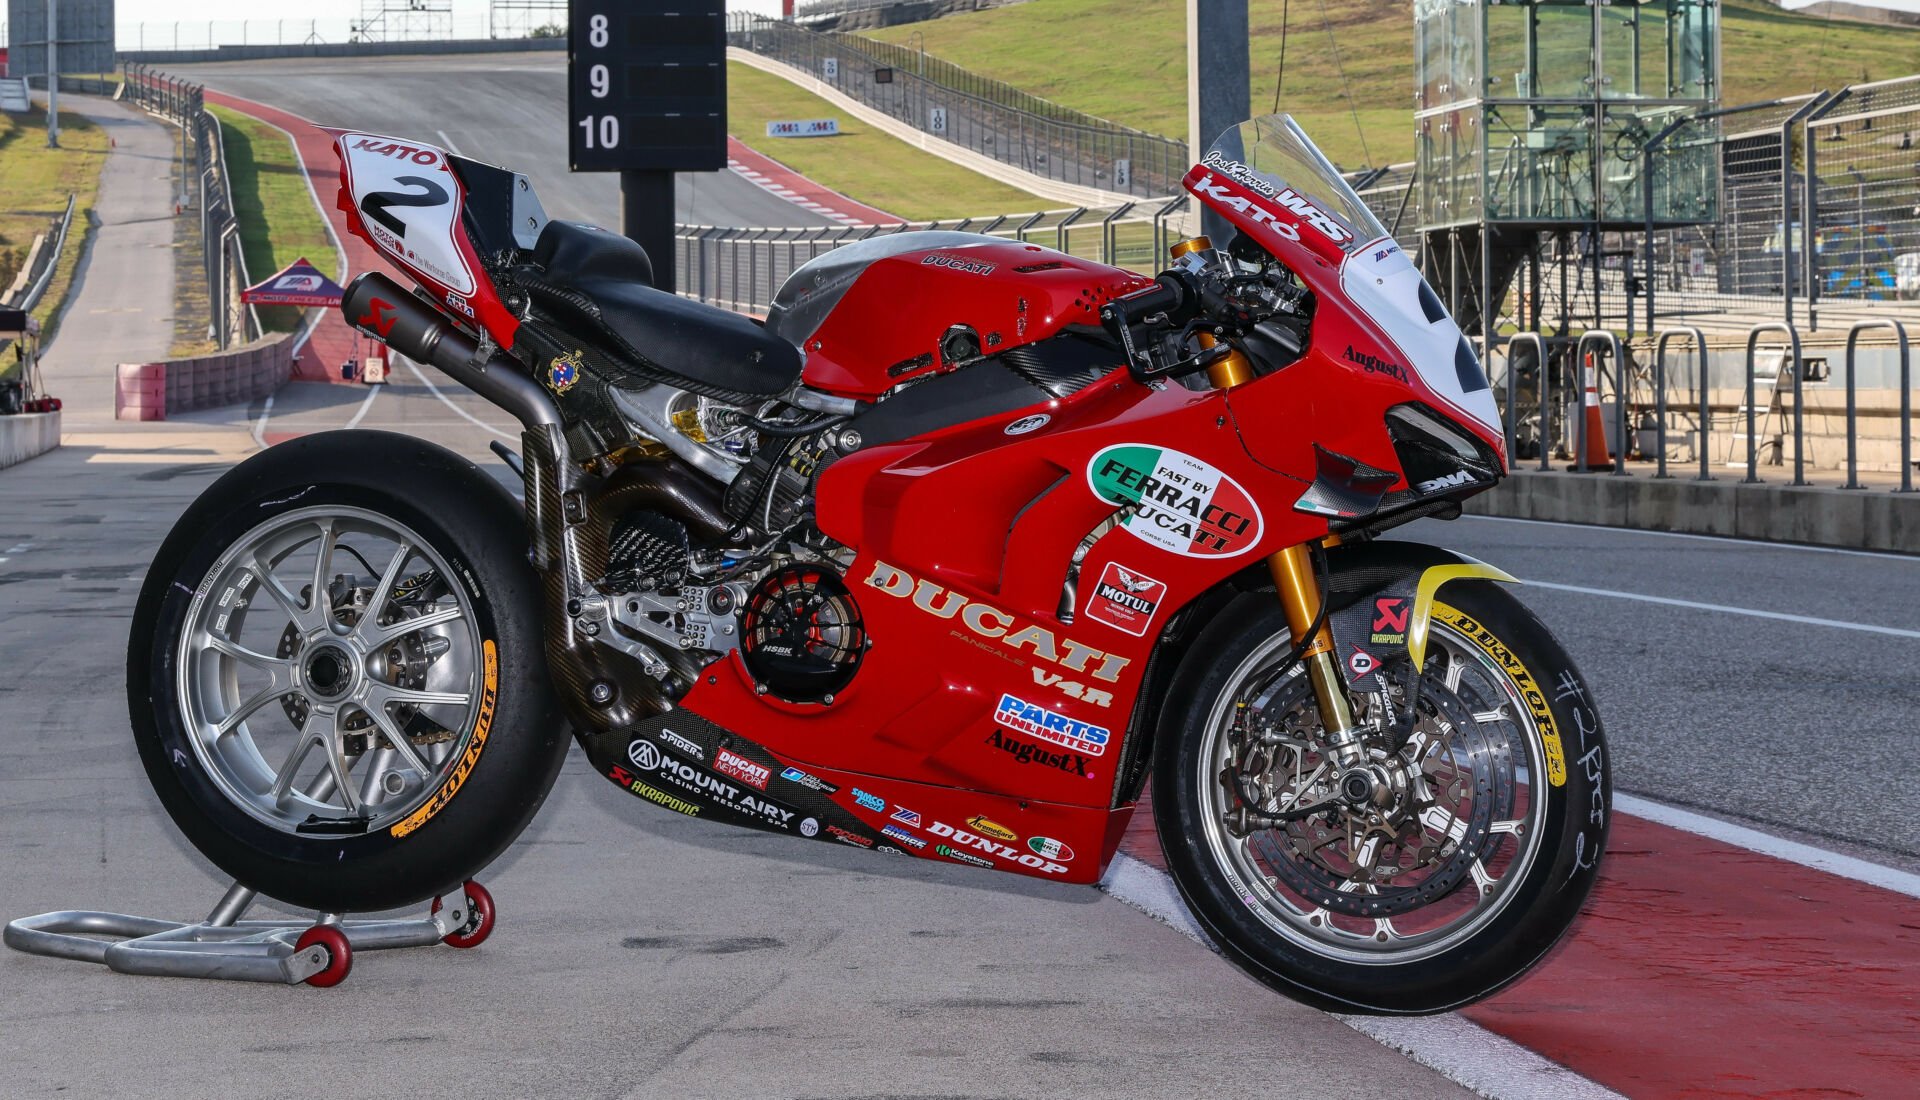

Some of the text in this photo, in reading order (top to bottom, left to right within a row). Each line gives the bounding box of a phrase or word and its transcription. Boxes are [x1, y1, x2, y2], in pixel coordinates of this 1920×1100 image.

[590, 14, 609, 48] 8
[590, 64, 609, 98] 9
[579, 115, 619, 149] 10
[352, 139, 438, 165] KATO
[1203, 151, 1275, 196] Josh Herrin
[361, 176, 449, 239] 2
[1193, 177, 1301, 242] KATO
[1274, 188, 1354, 244] WRS
[921, 255, 996, 276] DUCATI
[1157, 466, 1213, 495] FAST BY
[1183, 459, 1204, 472] TEAM
[1099, 458, 1252, 536] FERRACCI
[1140, 529, 1176, 548] CORSE USA
[1100, 584, 1150, 614] MOTUL
[863, 559, 1132, 684] DUCATI
[762, 645, 793, 654] HSBK
[949, 629, 1027, 668] PANIGALE
[1031, 666, 1115, 709] V4R
[1453, 616, 1556, 738] DUNLOP
[1374, 673, 1397, 727] SPIEGLER
[996, 710, 1103, 755] UNLIMITED
[999, 694, 1109, 745] PARTS
[660, 728, 703, 757] SPIDER
[715, 762, 764, 788] NEW YORK
[718, 751, 770, 779] DUCATI
[660, 755, 796, 823] MOUNT AIRY
[660, 772, 789, 830] CASINO RESORT SPA
[802, 776, 837, 793] SPECTRUM
[801, 822, 818, 834] STM
[881, 829, 928, 850] CHOICE
[926, 821, 1069, 875] DUNLOP
[951, 849, 994, 866] Keystone
